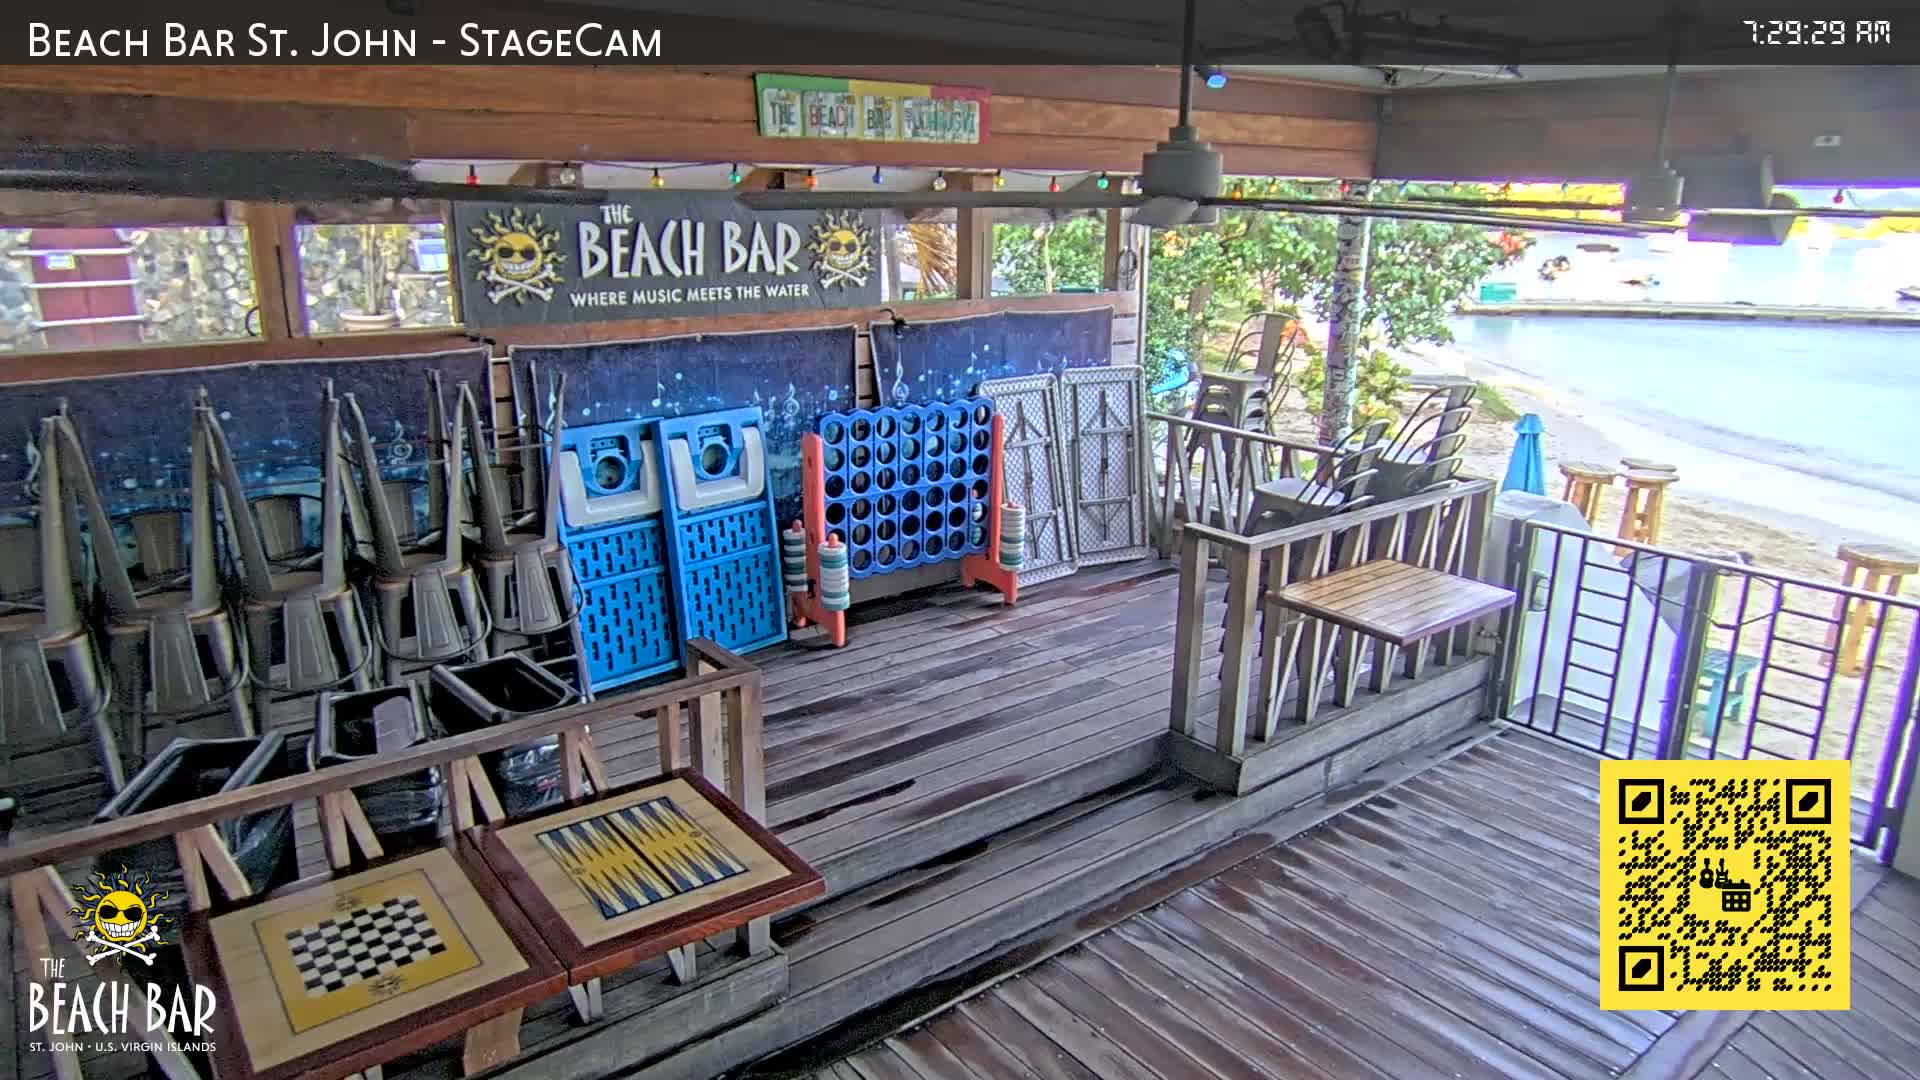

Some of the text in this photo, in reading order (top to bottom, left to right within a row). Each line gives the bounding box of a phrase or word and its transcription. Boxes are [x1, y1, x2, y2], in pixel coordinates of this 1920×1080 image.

[769, 102, 796, 126] THE
[808, 104, 855, 129] BEACH
[866, 107, 893, 129] BAR
[600, 204, 634, 224] THE
[578, 219, 801, 279] BEACH BAR
[569, 283, 809, 307] WHERE MUSIC MEETS THE WATER
